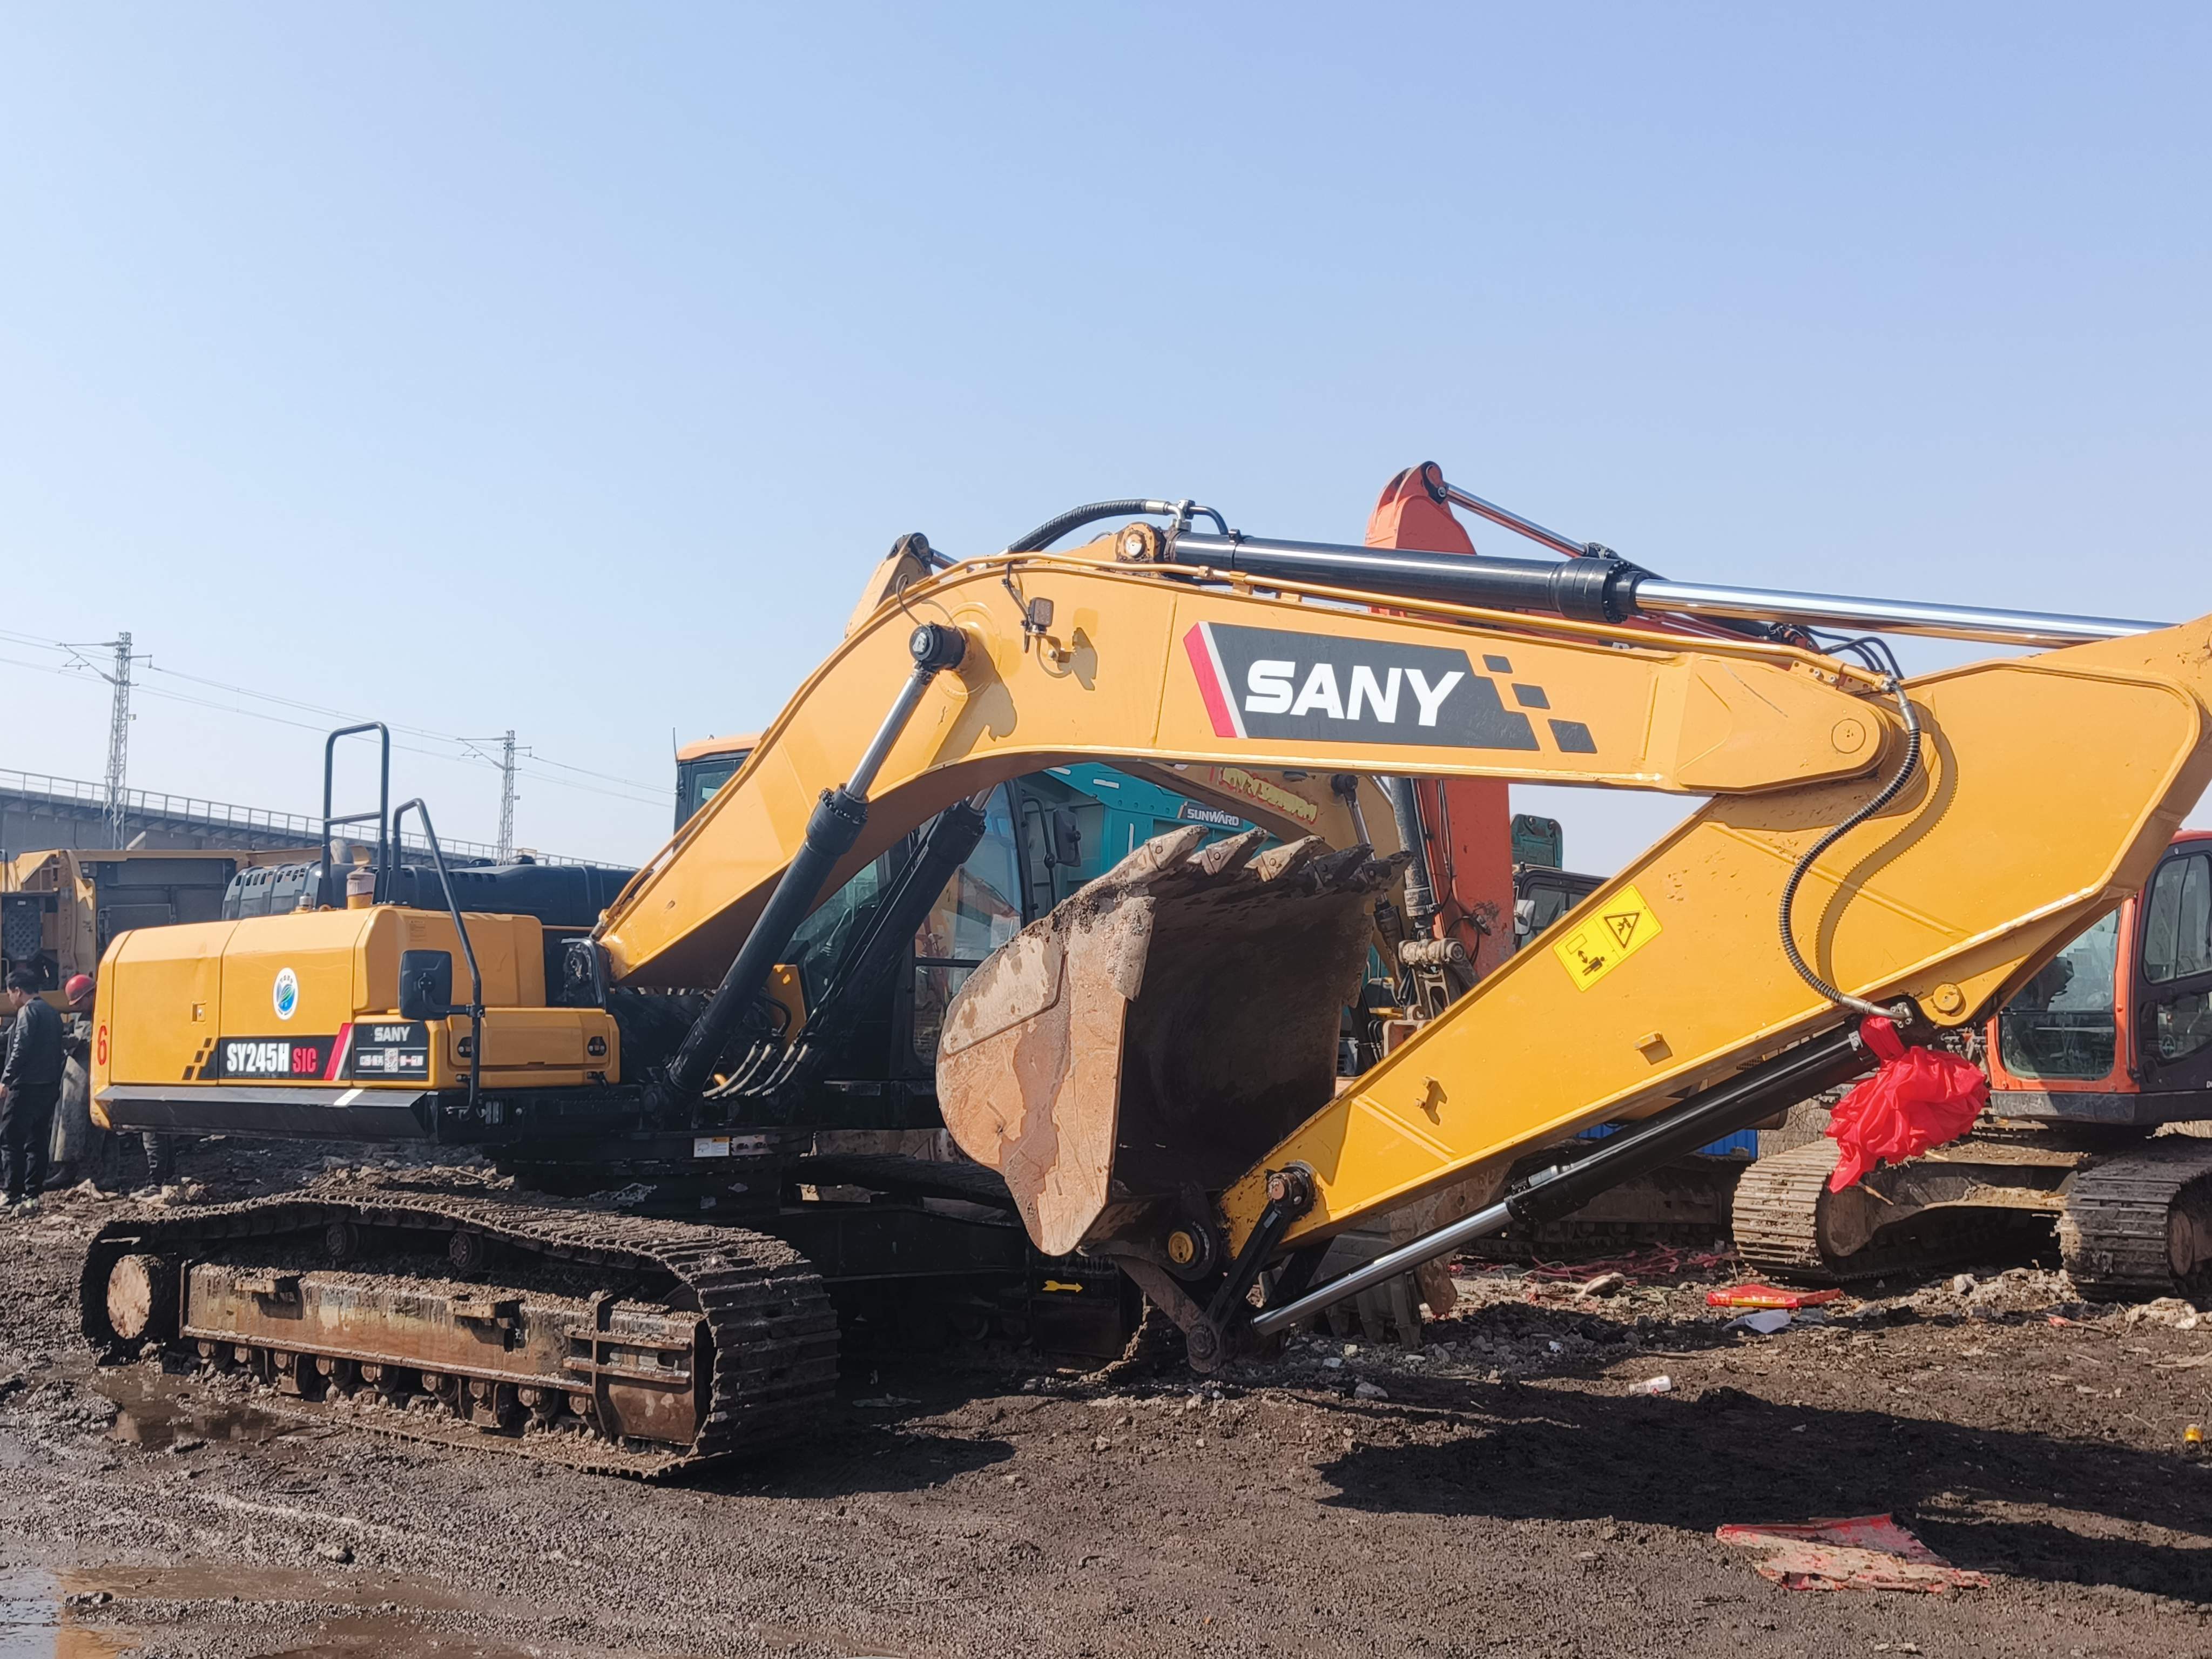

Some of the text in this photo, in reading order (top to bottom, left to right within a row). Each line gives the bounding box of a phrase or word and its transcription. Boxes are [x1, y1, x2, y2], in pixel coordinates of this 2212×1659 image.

[1245, 659, 1465, 727] SANY
[1187, 808, 1239, 826] SUNWARD
[97, 1025, 107, 1065] 6
[374, 1026, 410, 1042] SANY
[226, 1042, 318, 1073] SY245H SIC
